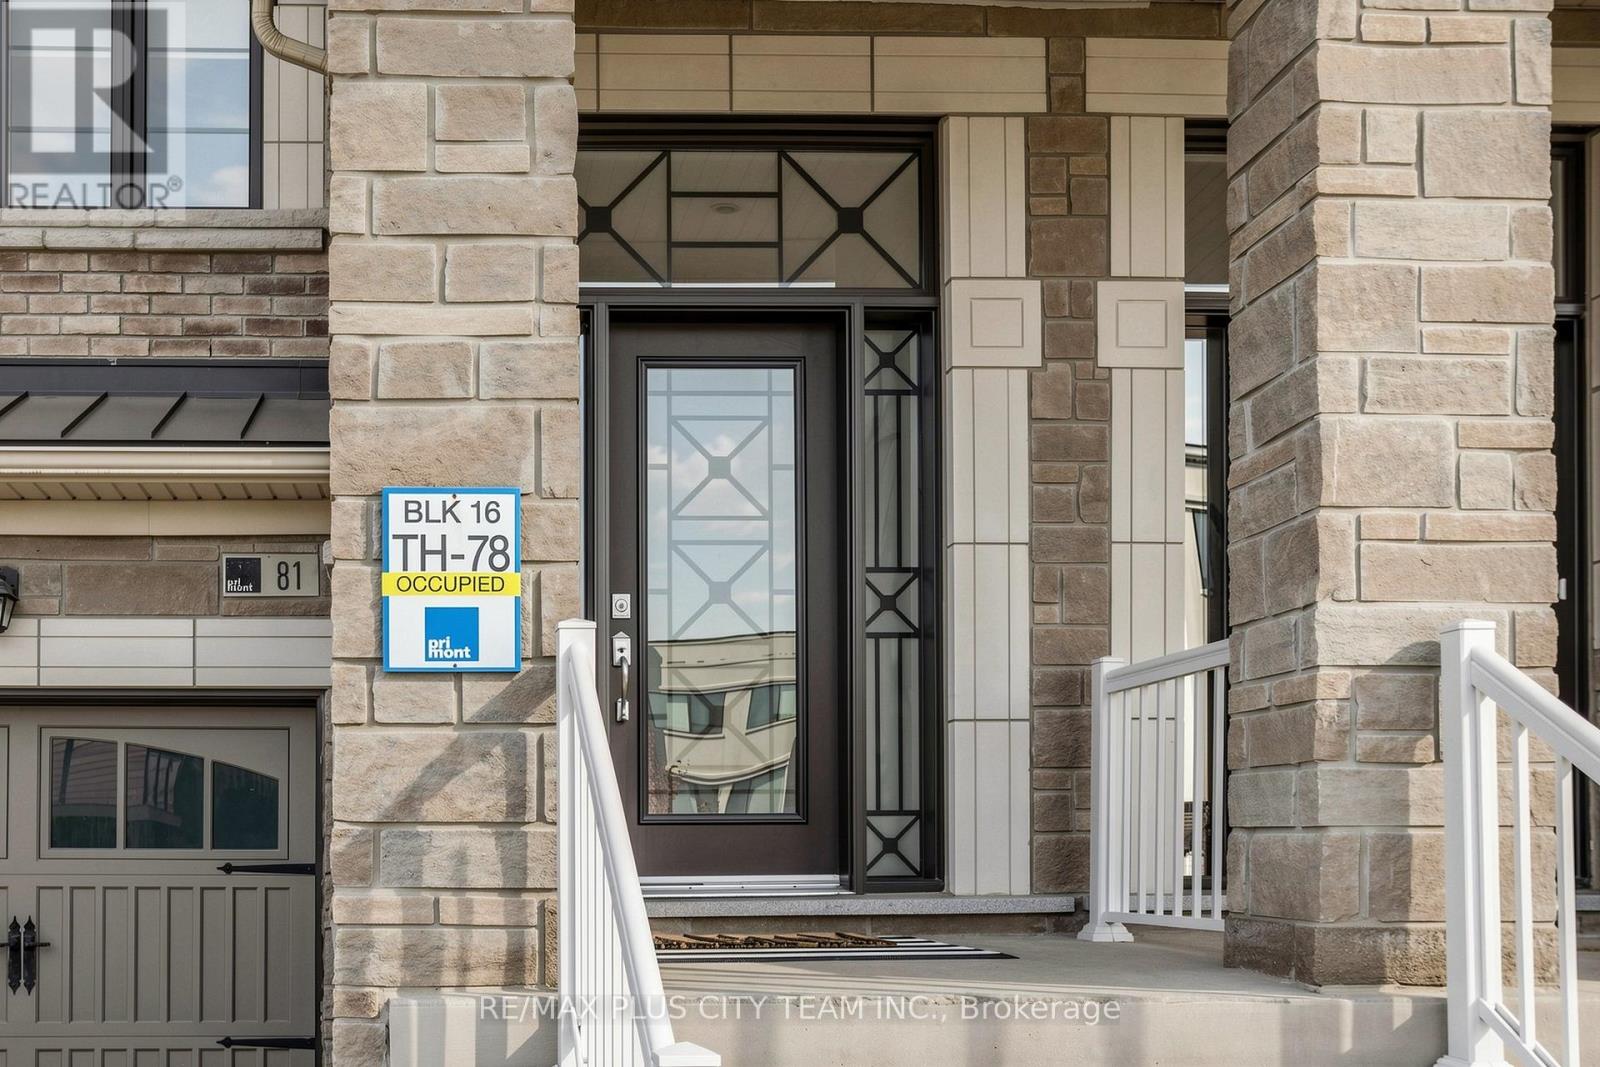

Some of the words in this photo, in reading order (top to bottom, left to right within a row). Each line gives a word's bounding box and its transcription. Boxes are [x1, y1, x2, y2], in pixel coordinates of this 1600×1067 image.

[404, 500, 461, 523] BLK
[470, 500, 501, 524] 16
[392, 534, 510, 572] TH-78
[277, 561, 301, 590] 81
[396, 575, 505, 593] OCCUPIED
[227, 582, 253, 592] mont
[428, 636, 450, 651] pri
[428, 646, 471, 659] mont
